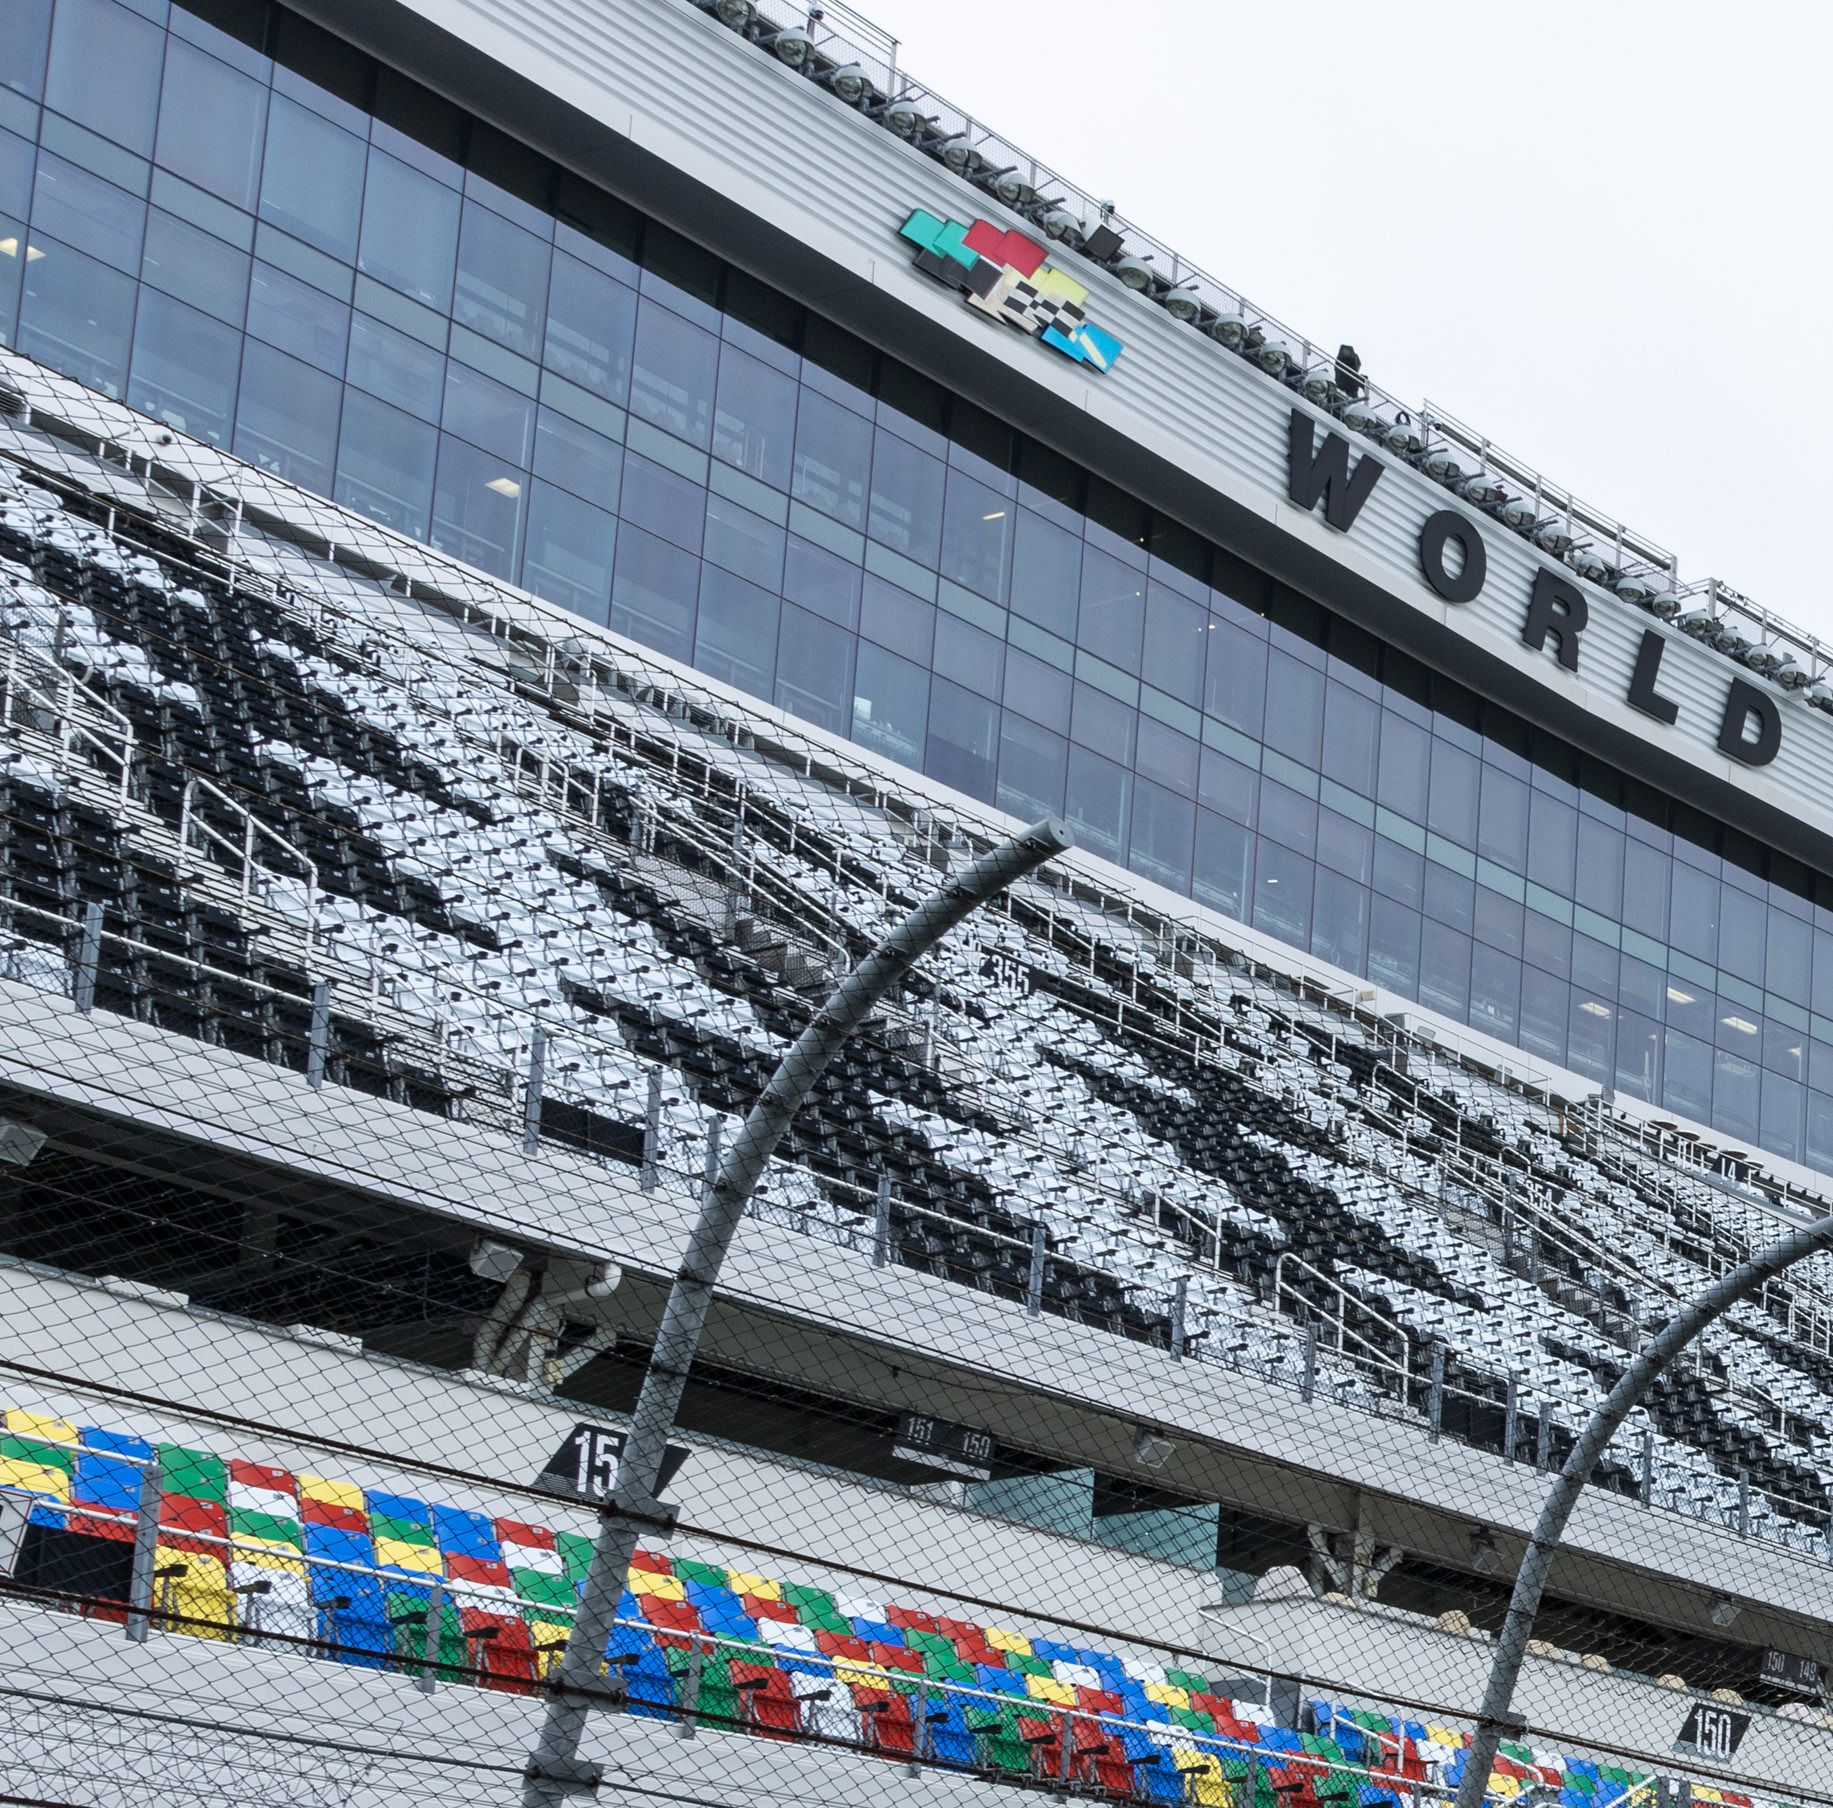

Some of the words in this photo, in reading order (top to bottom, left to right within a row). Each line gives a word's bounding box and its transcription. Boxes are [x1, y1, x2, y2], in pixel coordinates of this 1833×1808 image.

[1287, 407, 1783, 768] WORLD
[992, 955, 1030, 995] 355
[907, 1417, 933, 1445] 151
[574, 1430, 622, 1497] 15
[1695, 1708, 1731, 1758] 150
